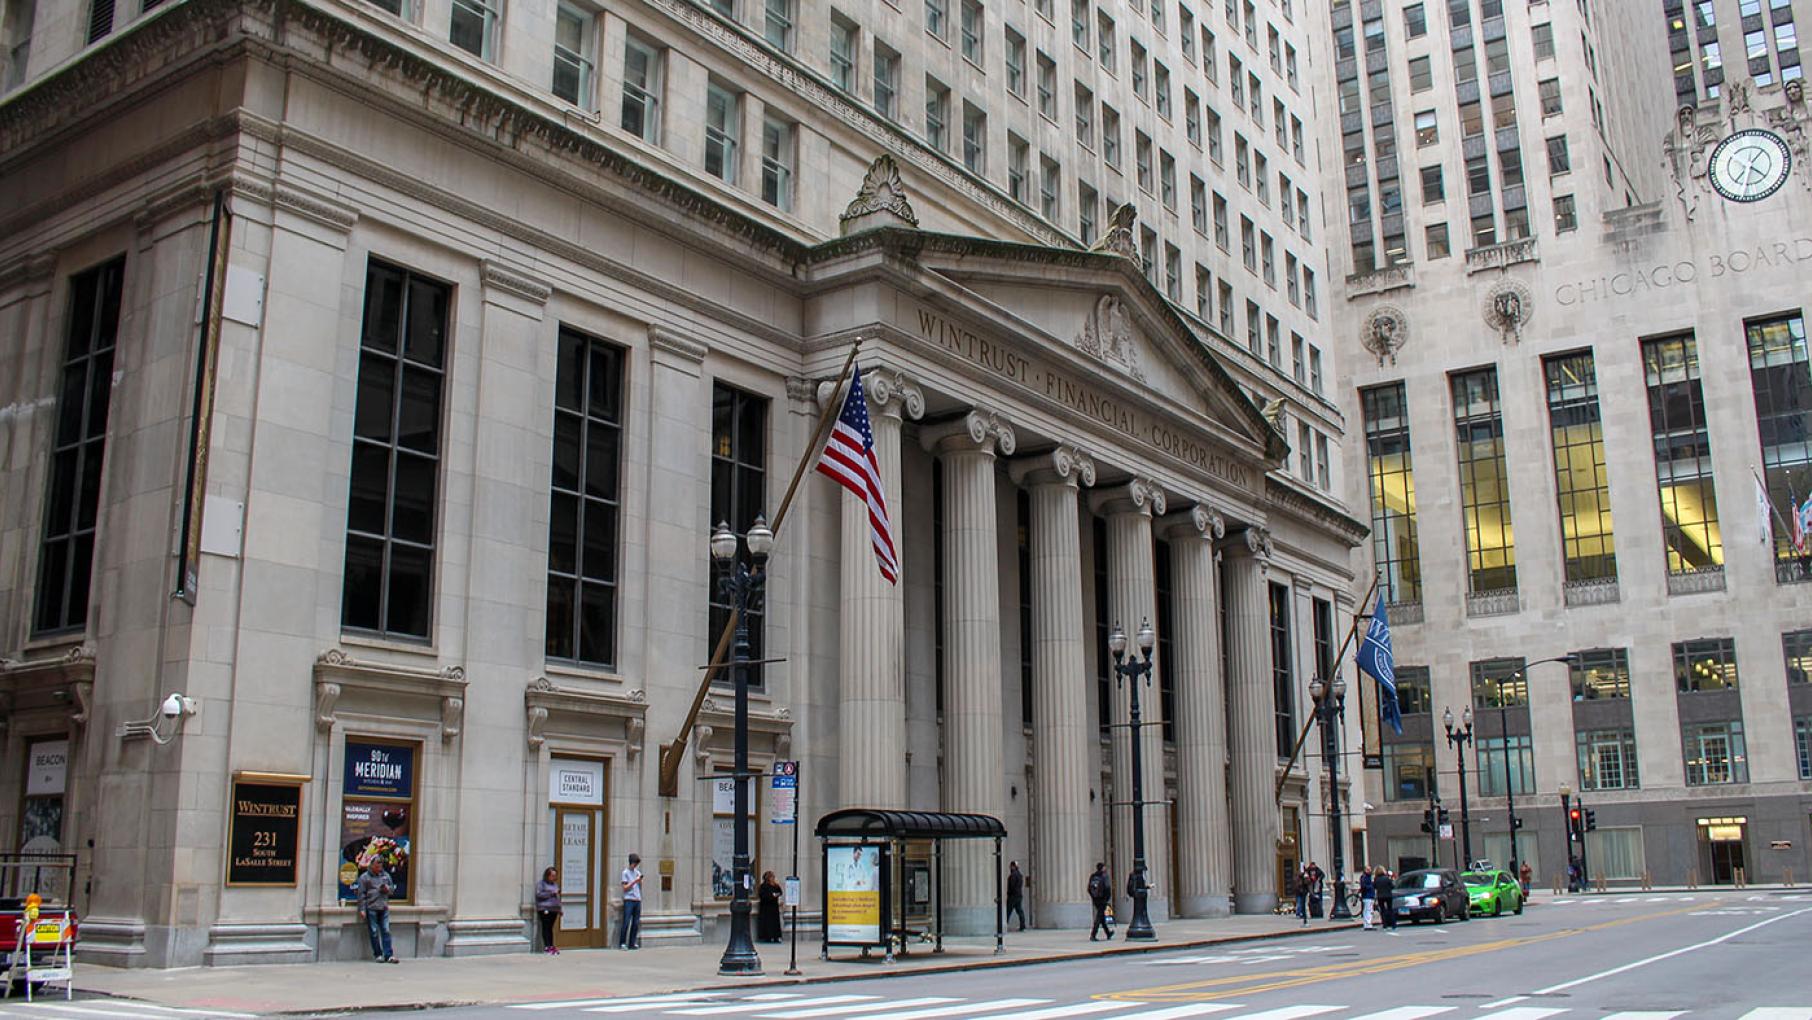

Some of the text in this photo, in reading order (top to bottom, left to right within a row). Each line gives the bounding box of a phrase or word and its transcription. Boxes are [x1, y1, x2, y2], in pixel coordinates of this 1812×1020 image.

[1555, 238, 1812, 307] CHICAGO BOARD
[917, 308, 1248, 487] WINTRUST FINANCIAL CORPORATION
[35, 753, 66, 767] BEACON
[354, 762, 402, 780] MERIDIAN
[563, 774, 589, 784] CENTRAL
[562, 783, 591, 793] STANDARD
[237, 800, 297, 817] WINTRUST
[253, 831, 277, 847] 231
